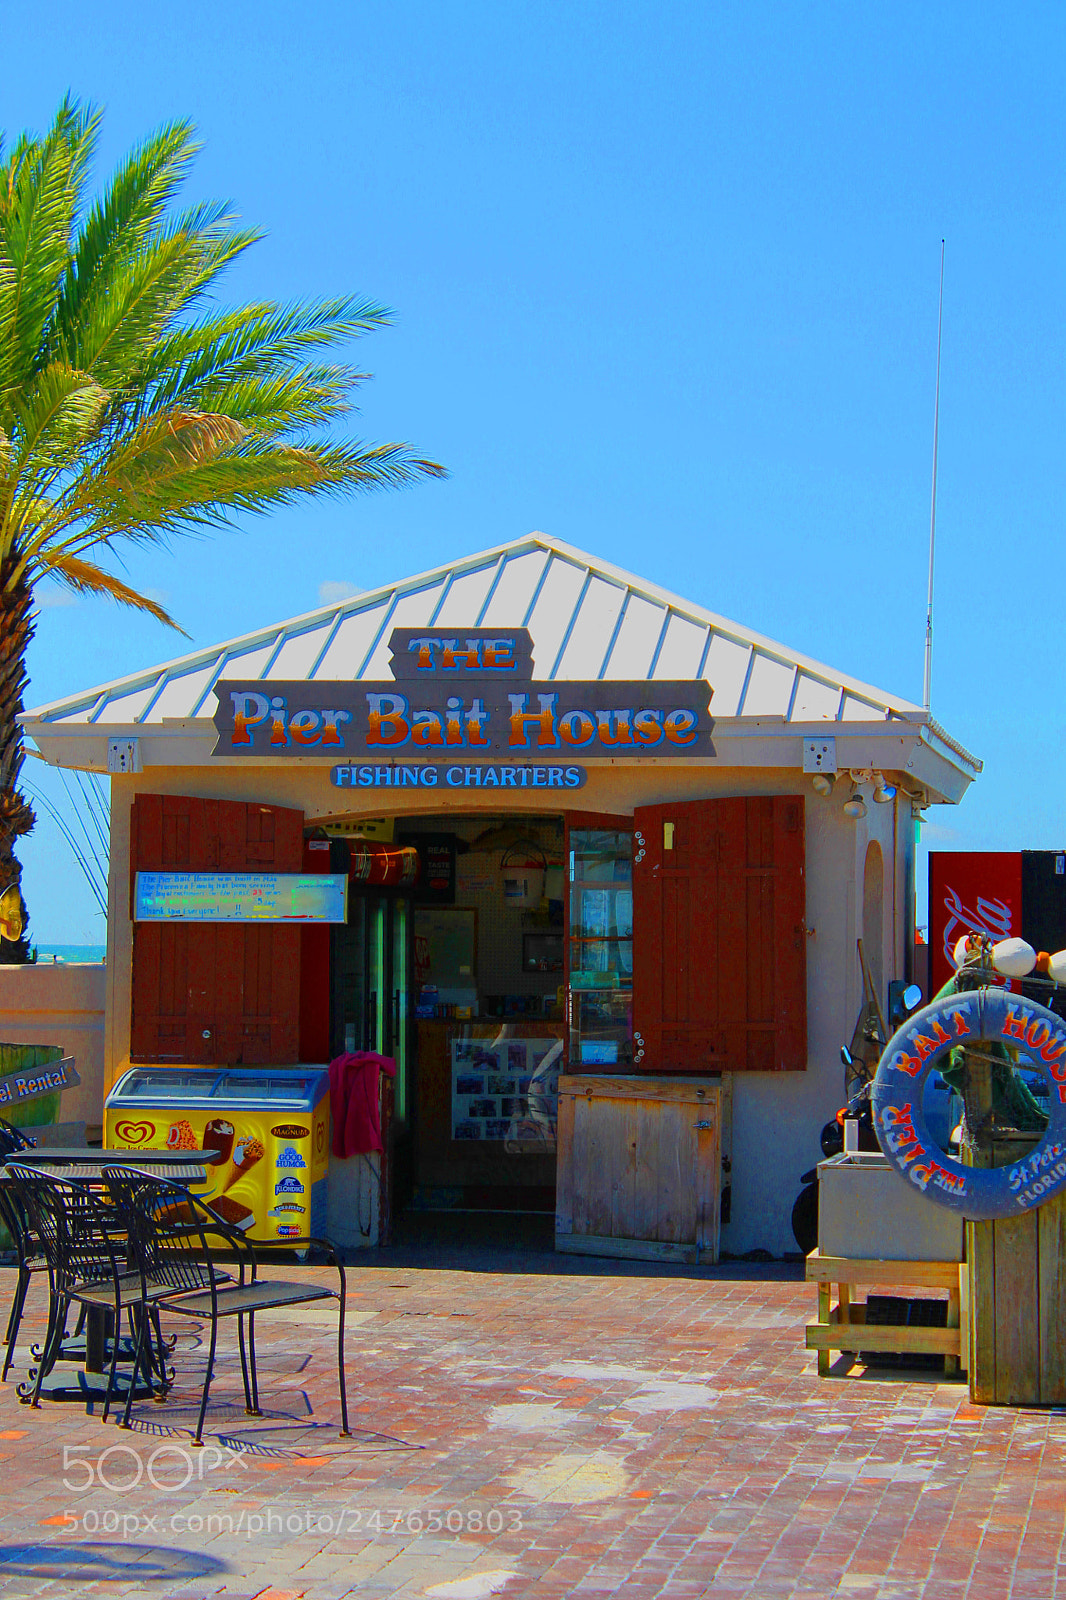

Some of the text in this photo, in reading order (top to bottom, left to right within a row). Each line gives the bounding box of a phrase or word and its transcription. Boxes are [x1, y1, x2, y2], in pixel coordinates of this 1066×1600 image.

[408, 637, 518, 671] THE
[230, 691, 700, 750] Pier Bait House
[335, 766, 581, 787] FISHING CHARTERS
[427, 846, 451, 854] REAL
[427, 861, 450, 869] TASTE
[887, 1001, 971, 1078] BAIT
[15, 1066, 67, 1097] Rental
[273, 1128, 308, 1136] MAGNUM
[278, 1153, 302, 1161] GOOD
[881, 1103, 942, 1193] PIER
[275, 1160, 307, 1168] HUMOR
[933, 1168, 968, 1196] THE
[1008, 1166, 1034, 1190] St.
